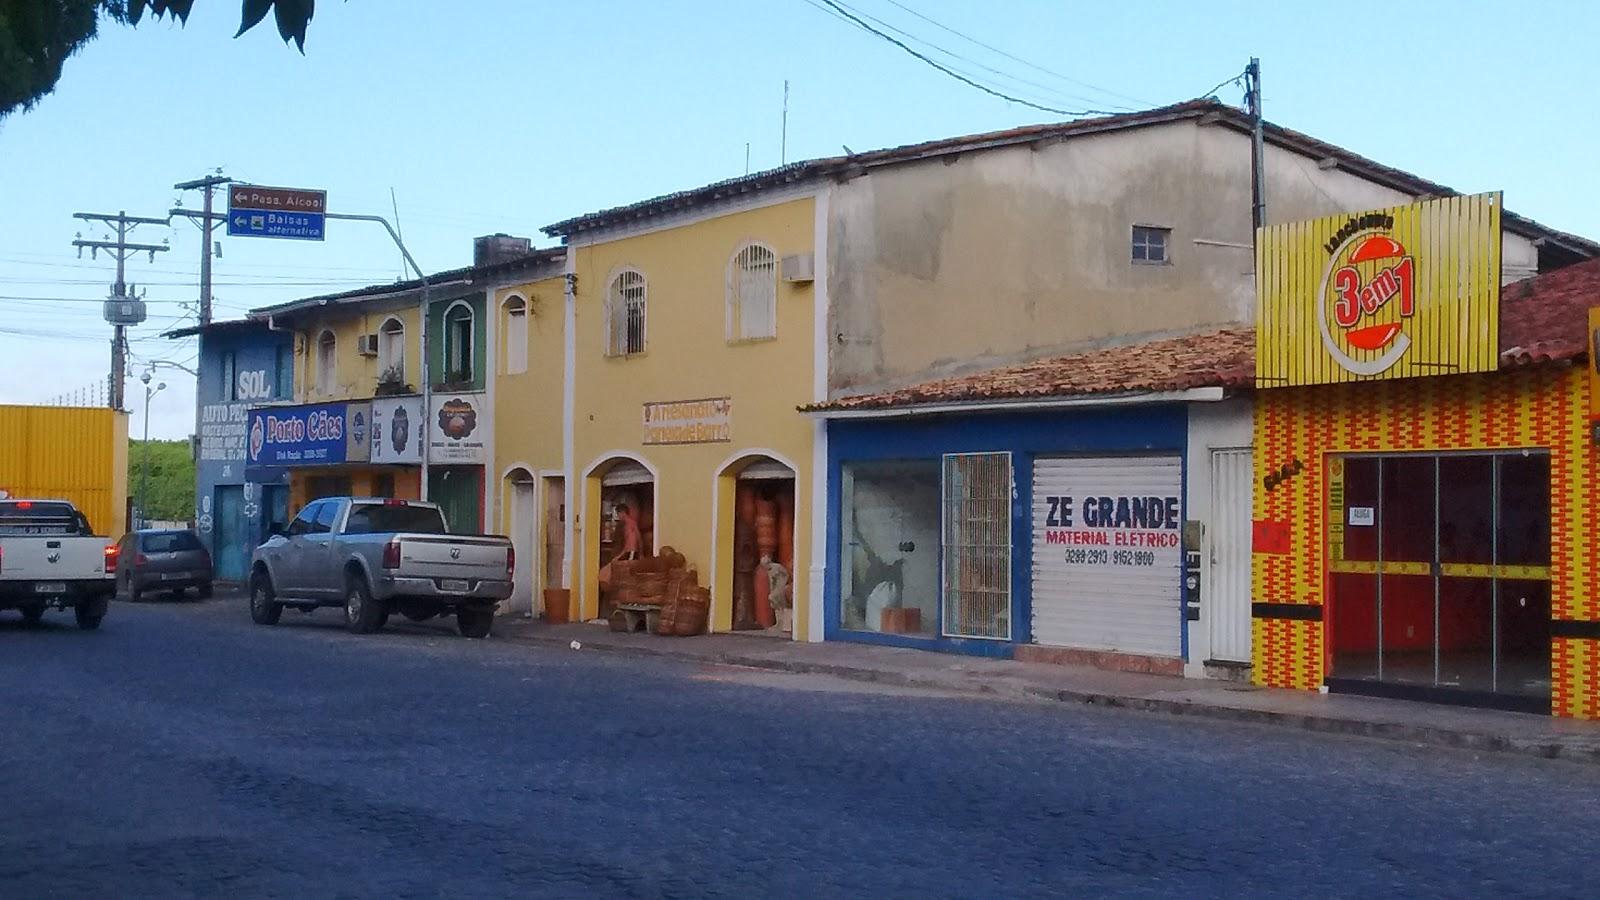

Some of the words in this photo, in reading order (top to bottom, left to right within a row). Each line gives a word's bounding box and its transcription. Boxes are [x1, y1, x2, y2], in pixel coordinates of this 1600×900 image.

[268, 214, 309, 225] Balsas
[268, 226, 320, 236] alternativa
[238, 370, 271, 400] SOL
[202, 404, 228, 422] AUTO
[1046, 496, 1073, 527] ZE
[1082, 496, 1179, 529] GRANDE
[1046, 531, 1110, 546] MATERIAL
[1115, 532, 1179, 548] ELETRICO
